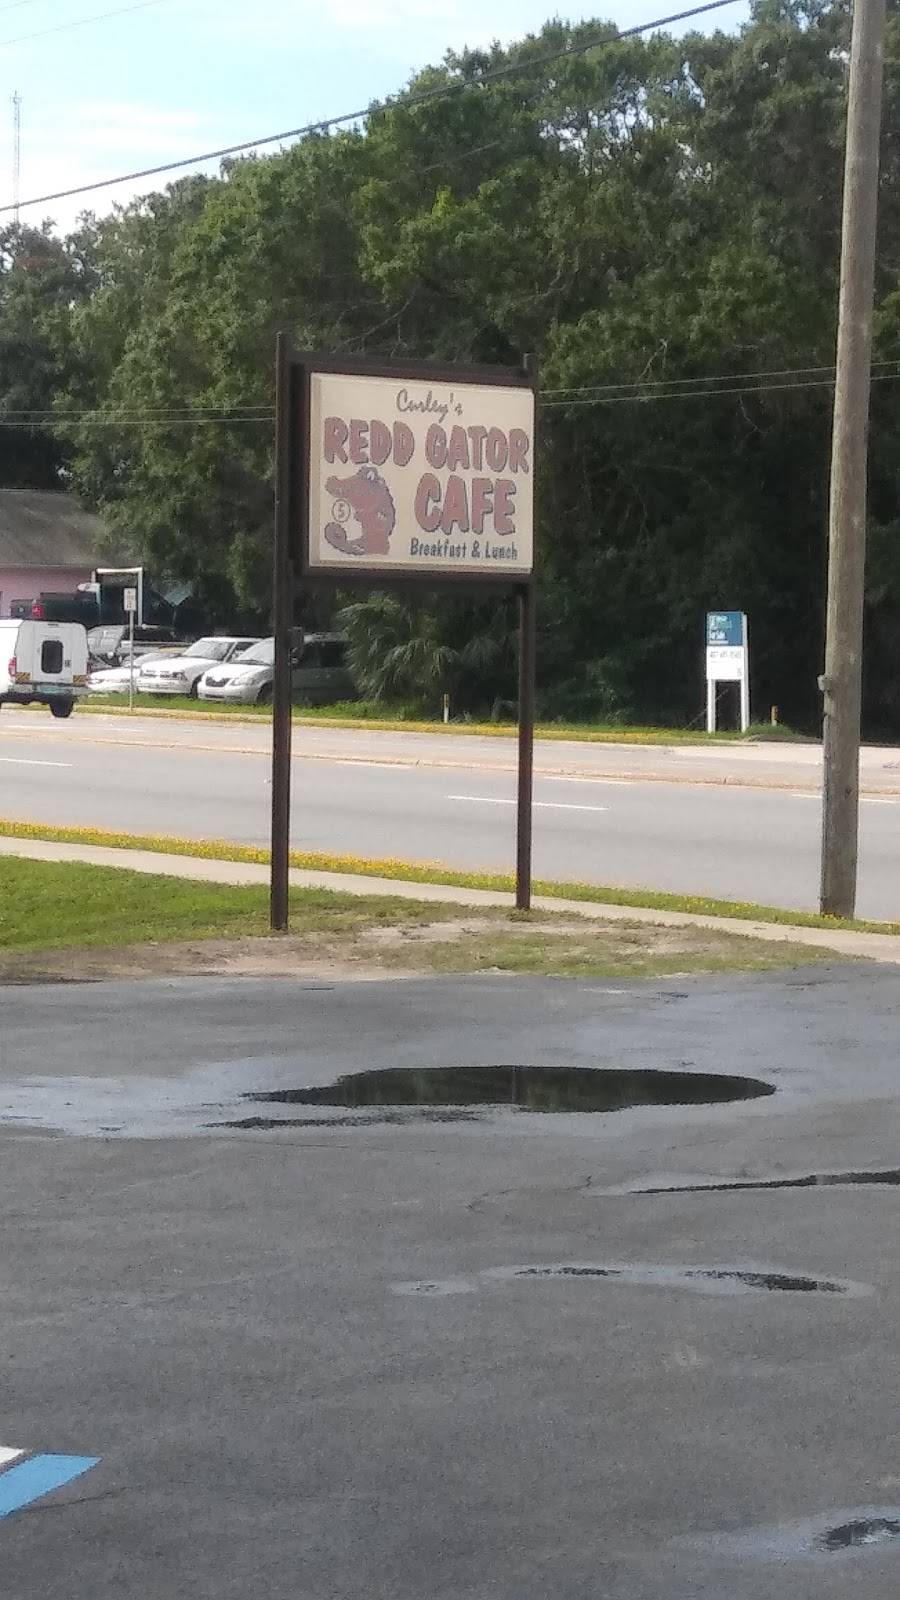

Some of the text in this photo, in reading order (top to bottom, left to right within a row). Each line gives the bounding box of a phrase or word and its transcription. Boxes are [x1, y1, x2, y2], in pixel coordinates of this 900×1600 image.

[396, 388, 463, 422] Curley's
[324, 416, 529, 474] REDD GATOR
[414, 472, 516, 535] CAFE
[410, 537, 518, 559] Breakfast & Lunch
